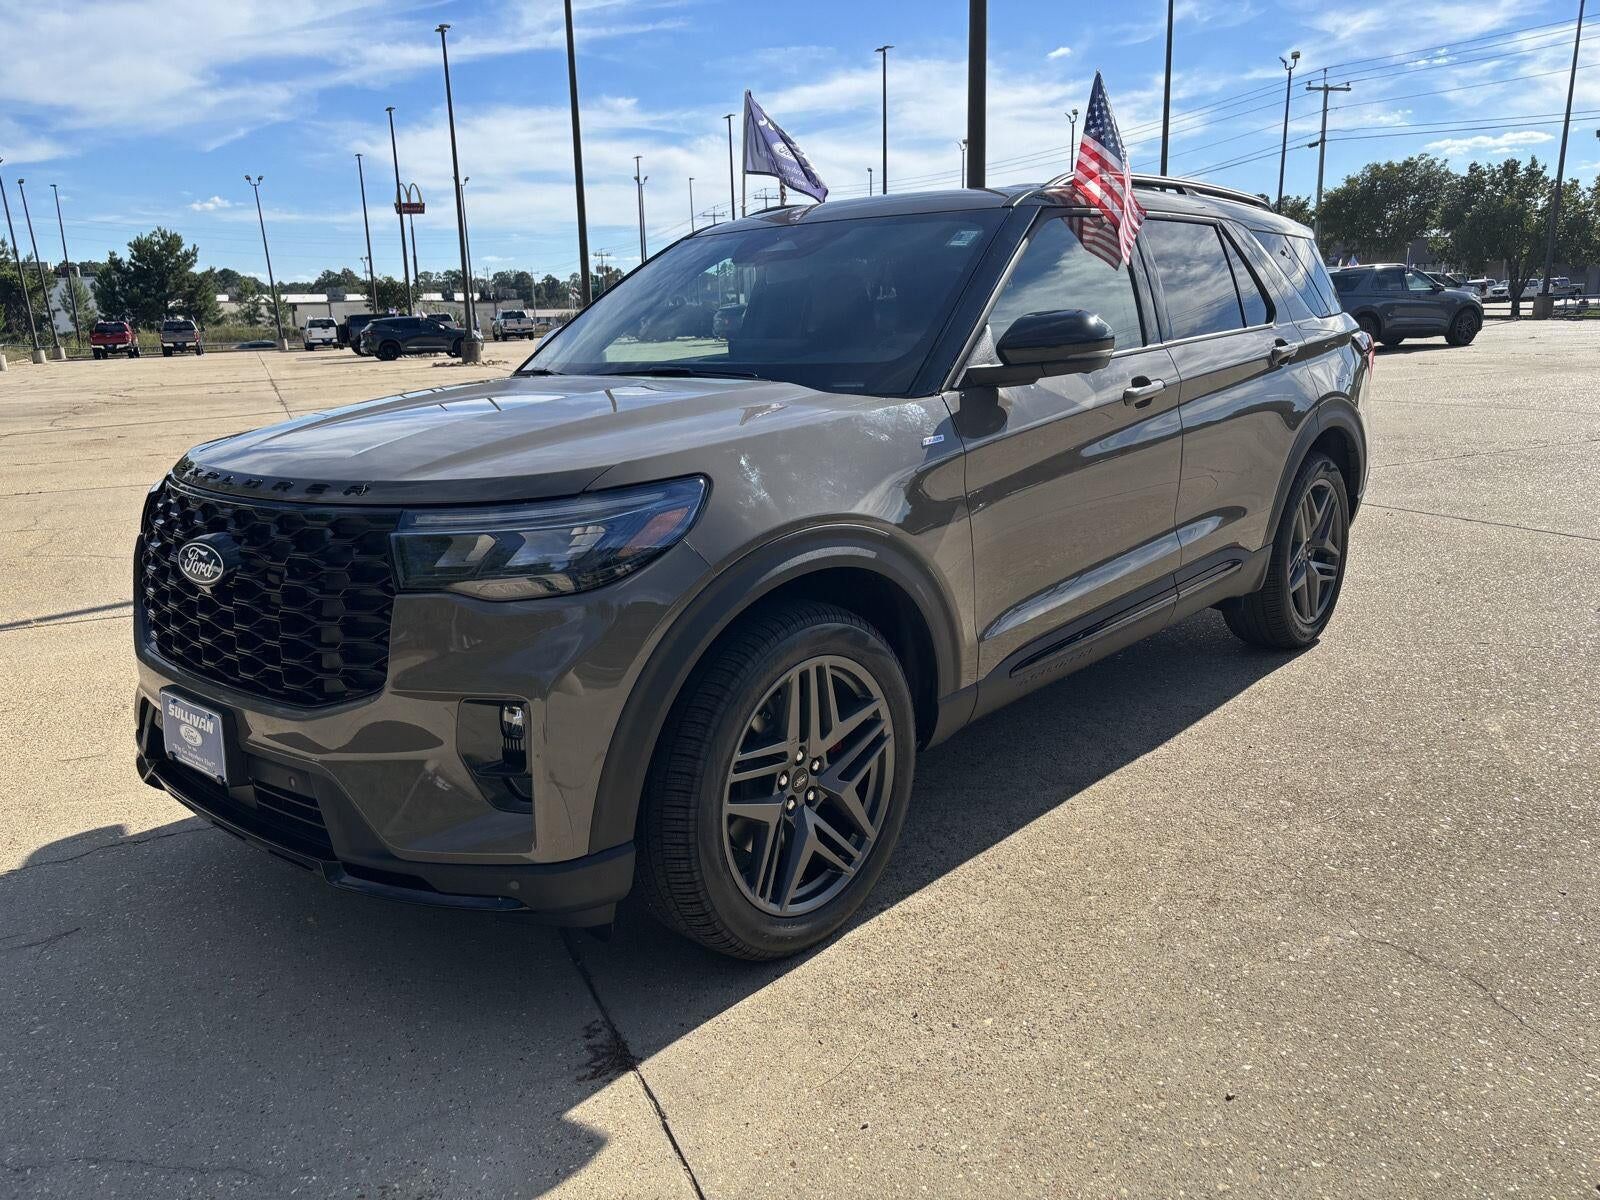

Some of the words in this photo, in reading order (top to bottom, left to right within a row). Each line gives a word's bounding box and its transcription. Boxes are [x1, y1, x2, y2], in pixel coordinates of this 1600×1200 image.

[184, 546, 216, 578] Ford
[168, 703, 214, 734] SULLIVAN
[184, 727, 199, 743] Ford
